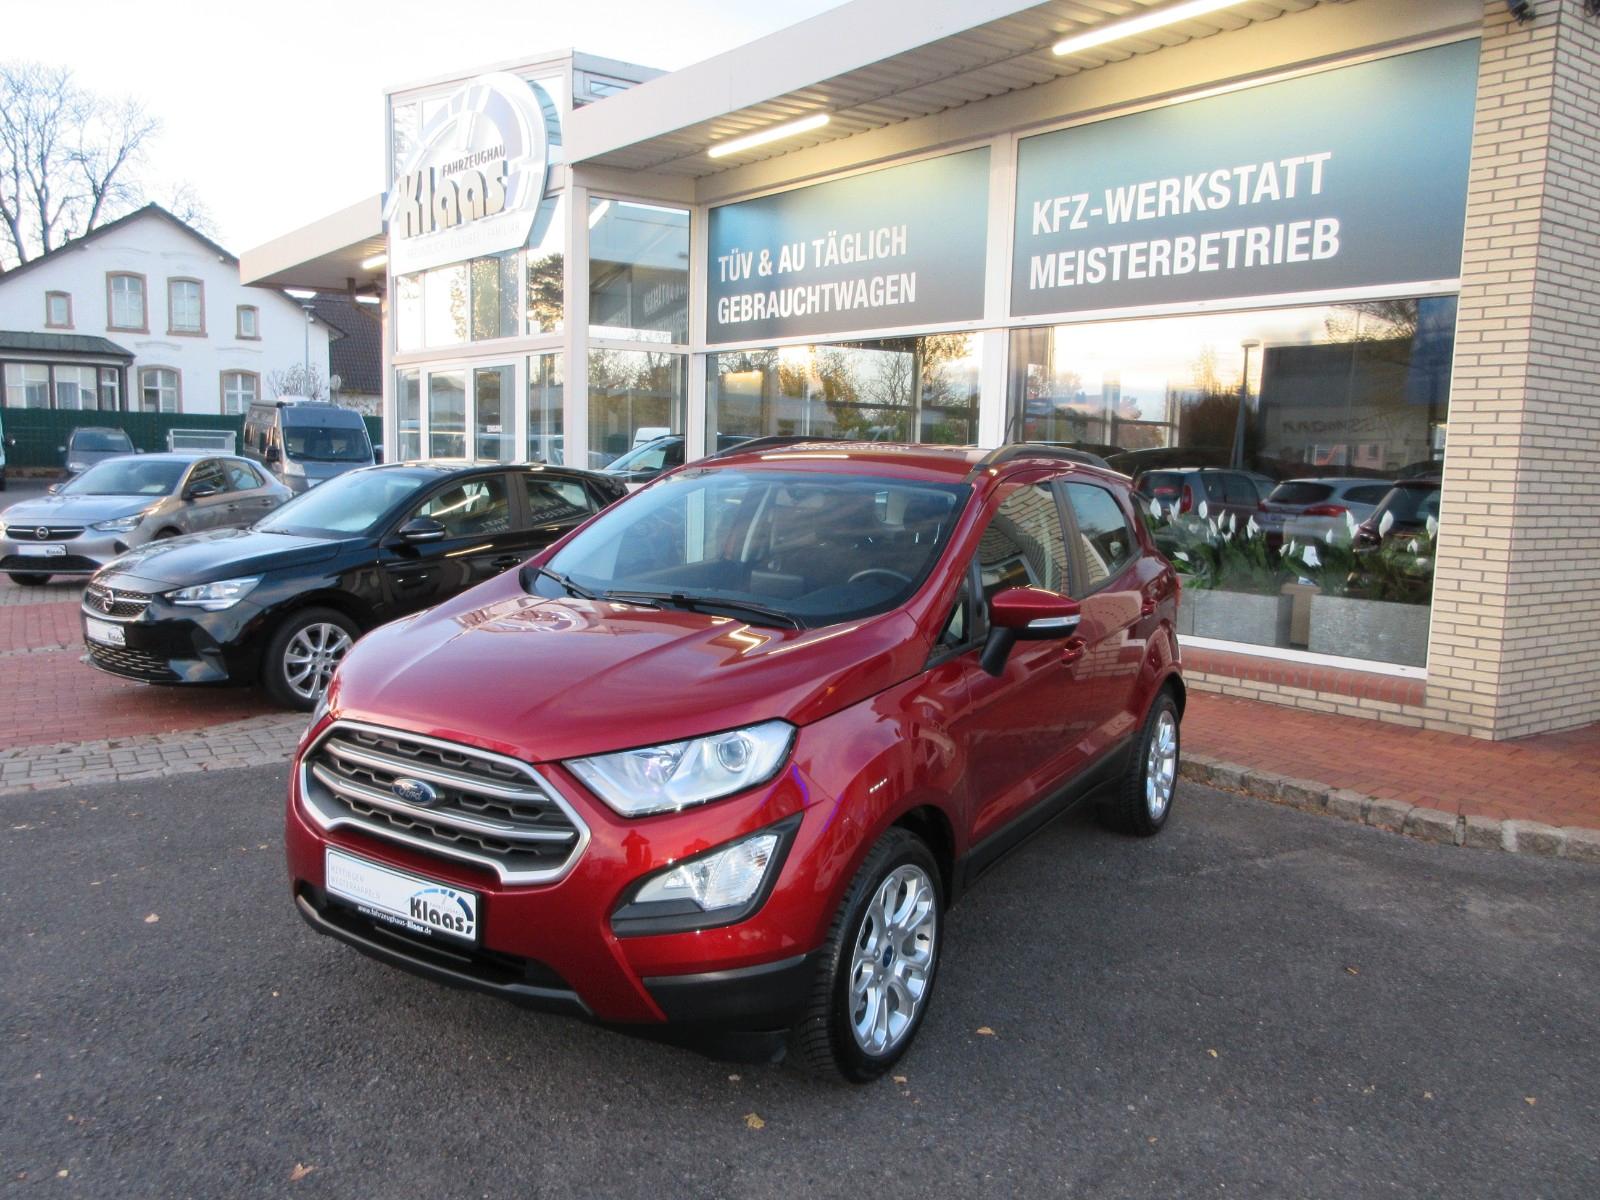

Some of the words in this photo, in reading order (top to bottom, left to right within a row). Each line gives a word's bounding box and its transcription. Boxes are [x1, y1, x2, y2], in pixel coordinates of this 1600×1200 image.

[398, 160, 508, 239] Klaas
[1032, 151, 1332, 236] KFZ-WERKSTATT
[718, 248, 752, 282] TÜV
[758, 249, 772, 277] &
[778, 240, 805, 274] AU
[812, 224, 907, 268] TÄGLICH
[1029, 217, 1341, 290] MEISTERBETRIEB
[717, 271, 917, 325] GEBRAUCHTWAGEN
[410, 896, 466, 932] Klaas
